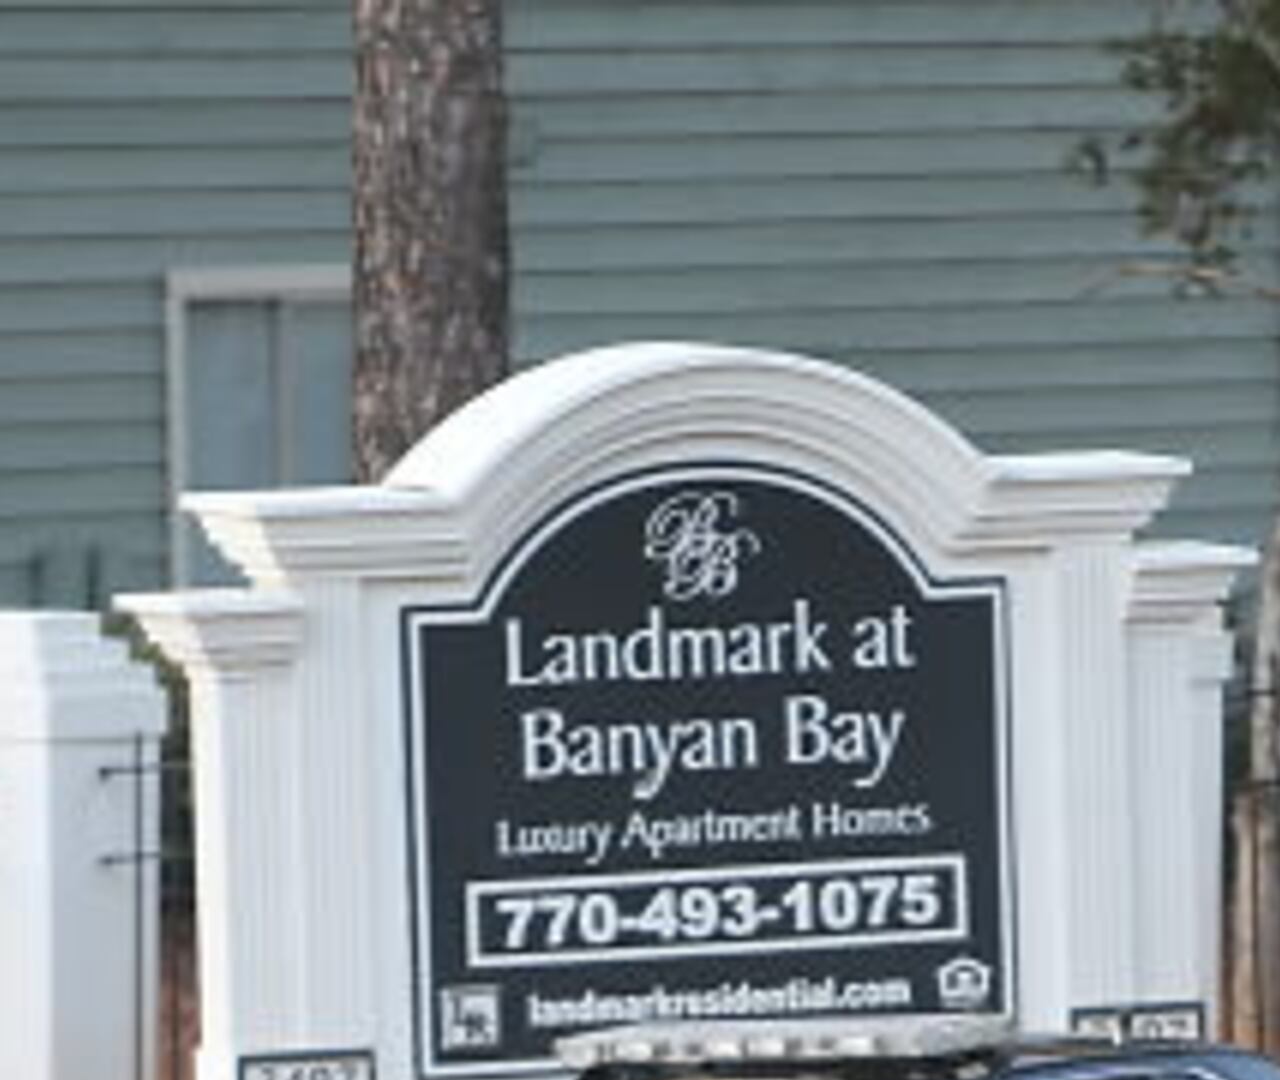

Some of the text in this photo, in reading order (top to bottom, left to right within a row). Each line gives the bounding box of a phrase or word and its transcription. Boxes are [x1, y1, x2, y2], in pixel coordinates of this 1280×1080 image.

[506, 599, 916, 686] Landmark at
[521, 695, 904, 799] Banyan Bay
[495, 802, 932, 865] Luxury Apartment Homes
[495, 875, 940, 950] 770-493-1075
[530, 976, 912, 1028] landmarkresidential.com
